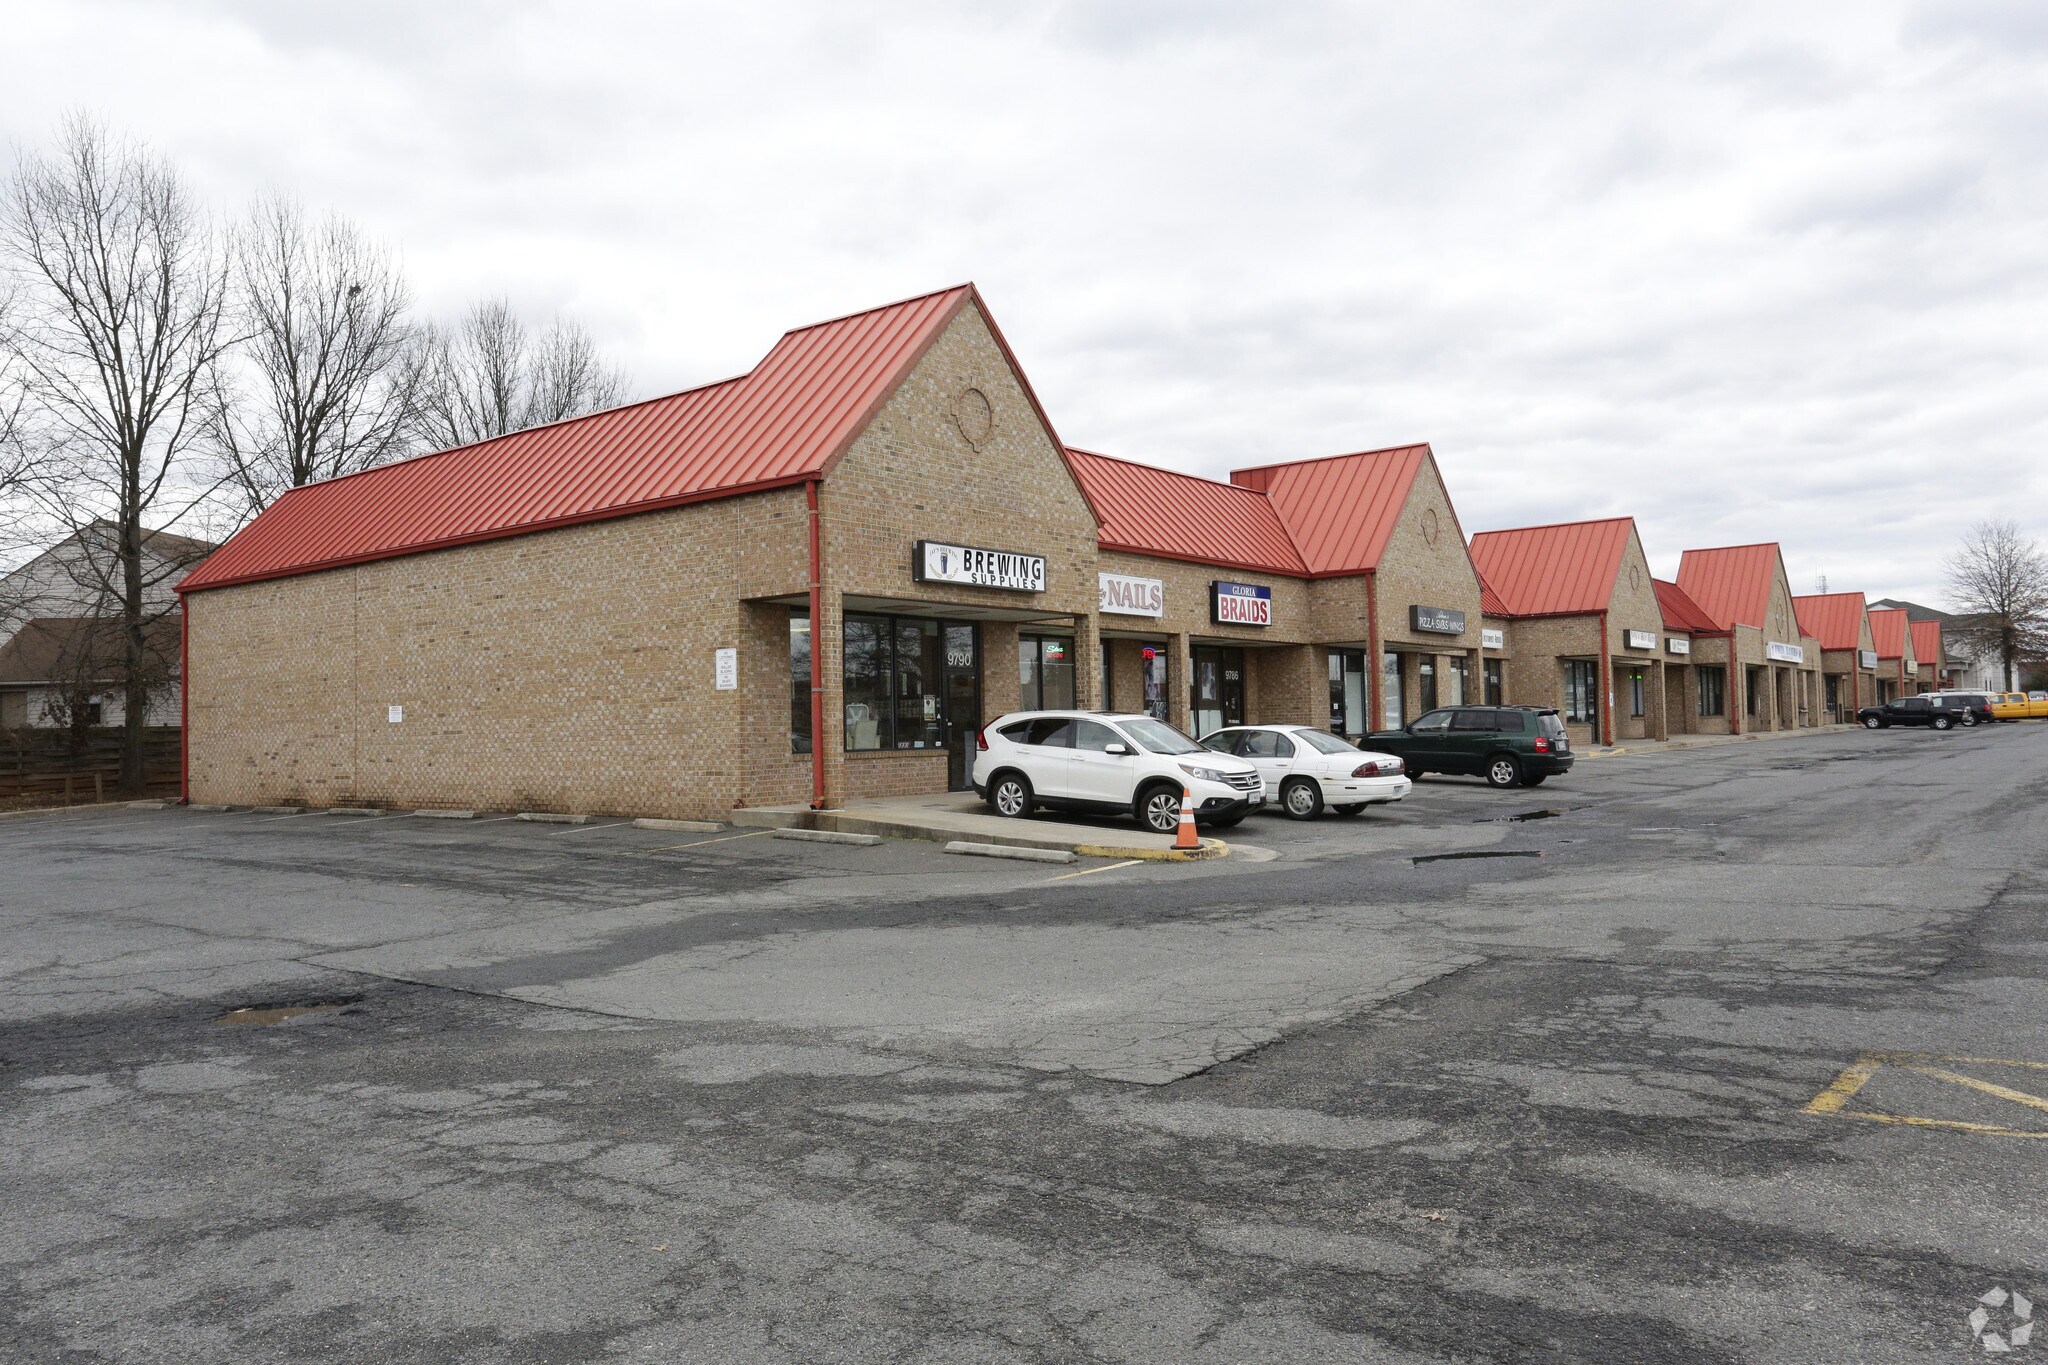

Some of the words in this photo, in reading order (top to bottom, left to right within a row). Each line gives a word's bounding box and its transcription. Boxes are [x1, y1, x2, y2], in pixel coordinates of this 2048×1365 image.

[963, 550, 1041, 580] BREWING
[972, 572, 1037, 590] SUPPLIES
[1107, 580, 1161, 611] NAILS
[1232, 586, 1256, 597] GLORIA
[1221, 597, 1268, 623] BRAIDS
[1419, 616, 1434, 628] PIZZA
[947, 652, 971, 666] 9790
[1225, 670, 1239, 680] 9786
